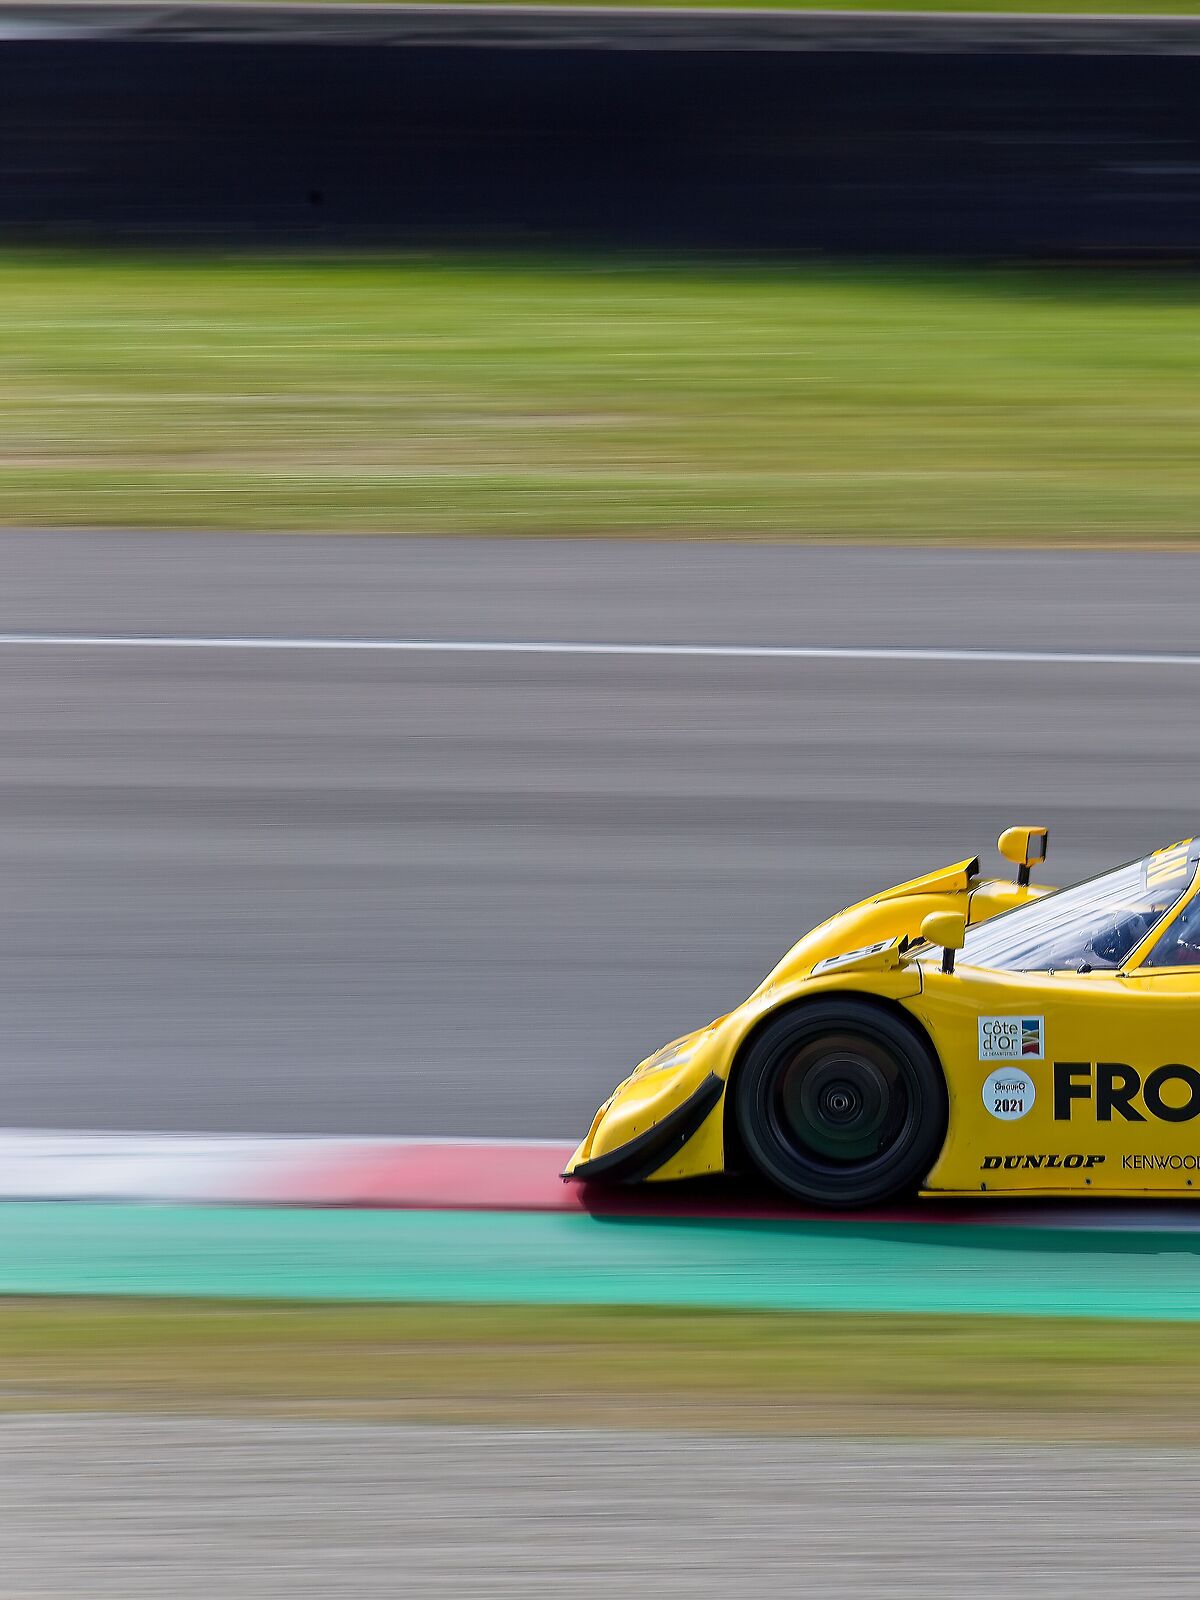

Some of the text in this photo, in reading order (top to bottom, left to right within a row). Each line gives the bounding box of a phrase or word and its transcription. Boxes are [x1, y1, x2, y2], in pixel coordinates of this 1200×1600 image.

[982, 1020, 1019, 1035] Côte
[983, 1034, 1019, 1050] d'Or
[994, 1098, 1023, 1112] 2021
[980, 1154, 1106, 1169] DUNLOP
